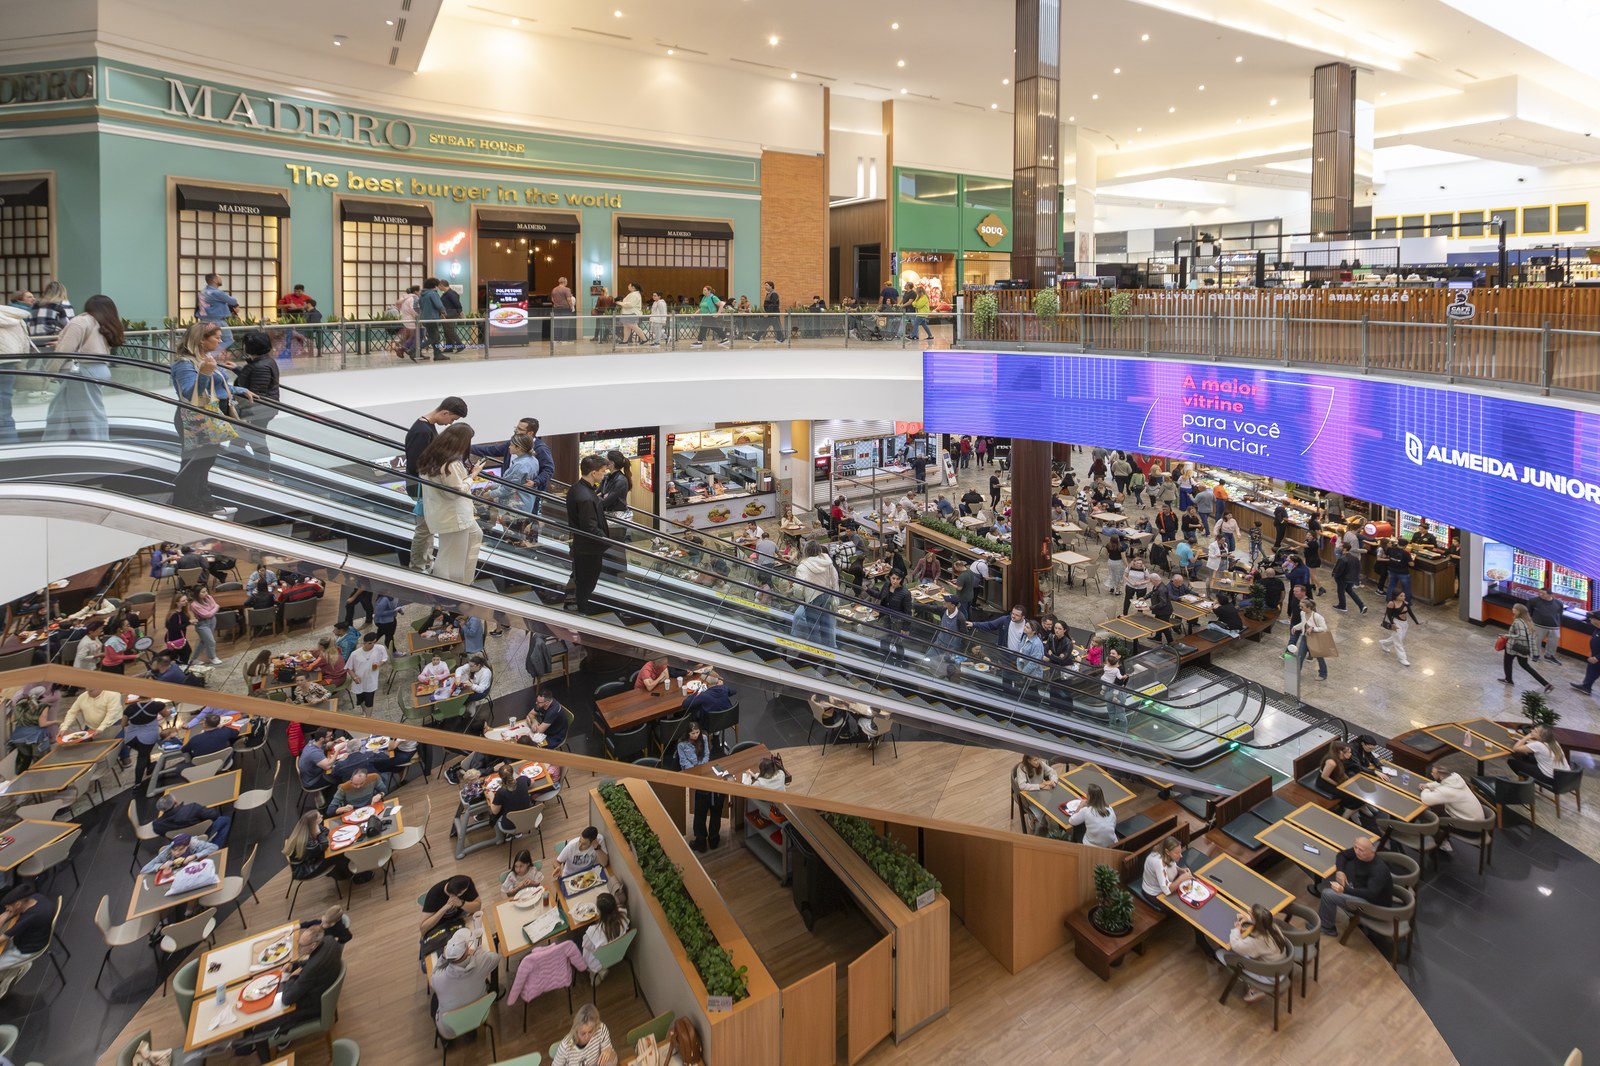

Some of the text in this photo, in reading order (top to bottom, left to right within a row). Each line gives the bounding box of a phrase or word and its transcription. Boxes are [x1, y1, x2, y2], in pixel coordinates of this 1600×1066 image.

[163, 77, 417, 151] MADERO
[429, 133, 526, 153] STEAK HOUSE
[285, 163, 623, 210] The best burger in the world
[218, 203, 261, 215] MADERO
[373, 214, 409, 225] MADERO
[516, 222, 547, 231] MADERO
[980, 224, 1003, 236] SOUQ
[1137, 290, 1204, 302] cultivar.
[1182, 374, 1260, 396] A maior
[1182, 393, 1244, 413] vitrine
[1182, 413, 1281, 439] para você
[1182, 432, 1271, 457] anunciar.
[1426, 444, 1600, 505] ALMEIDA JUNIOR
